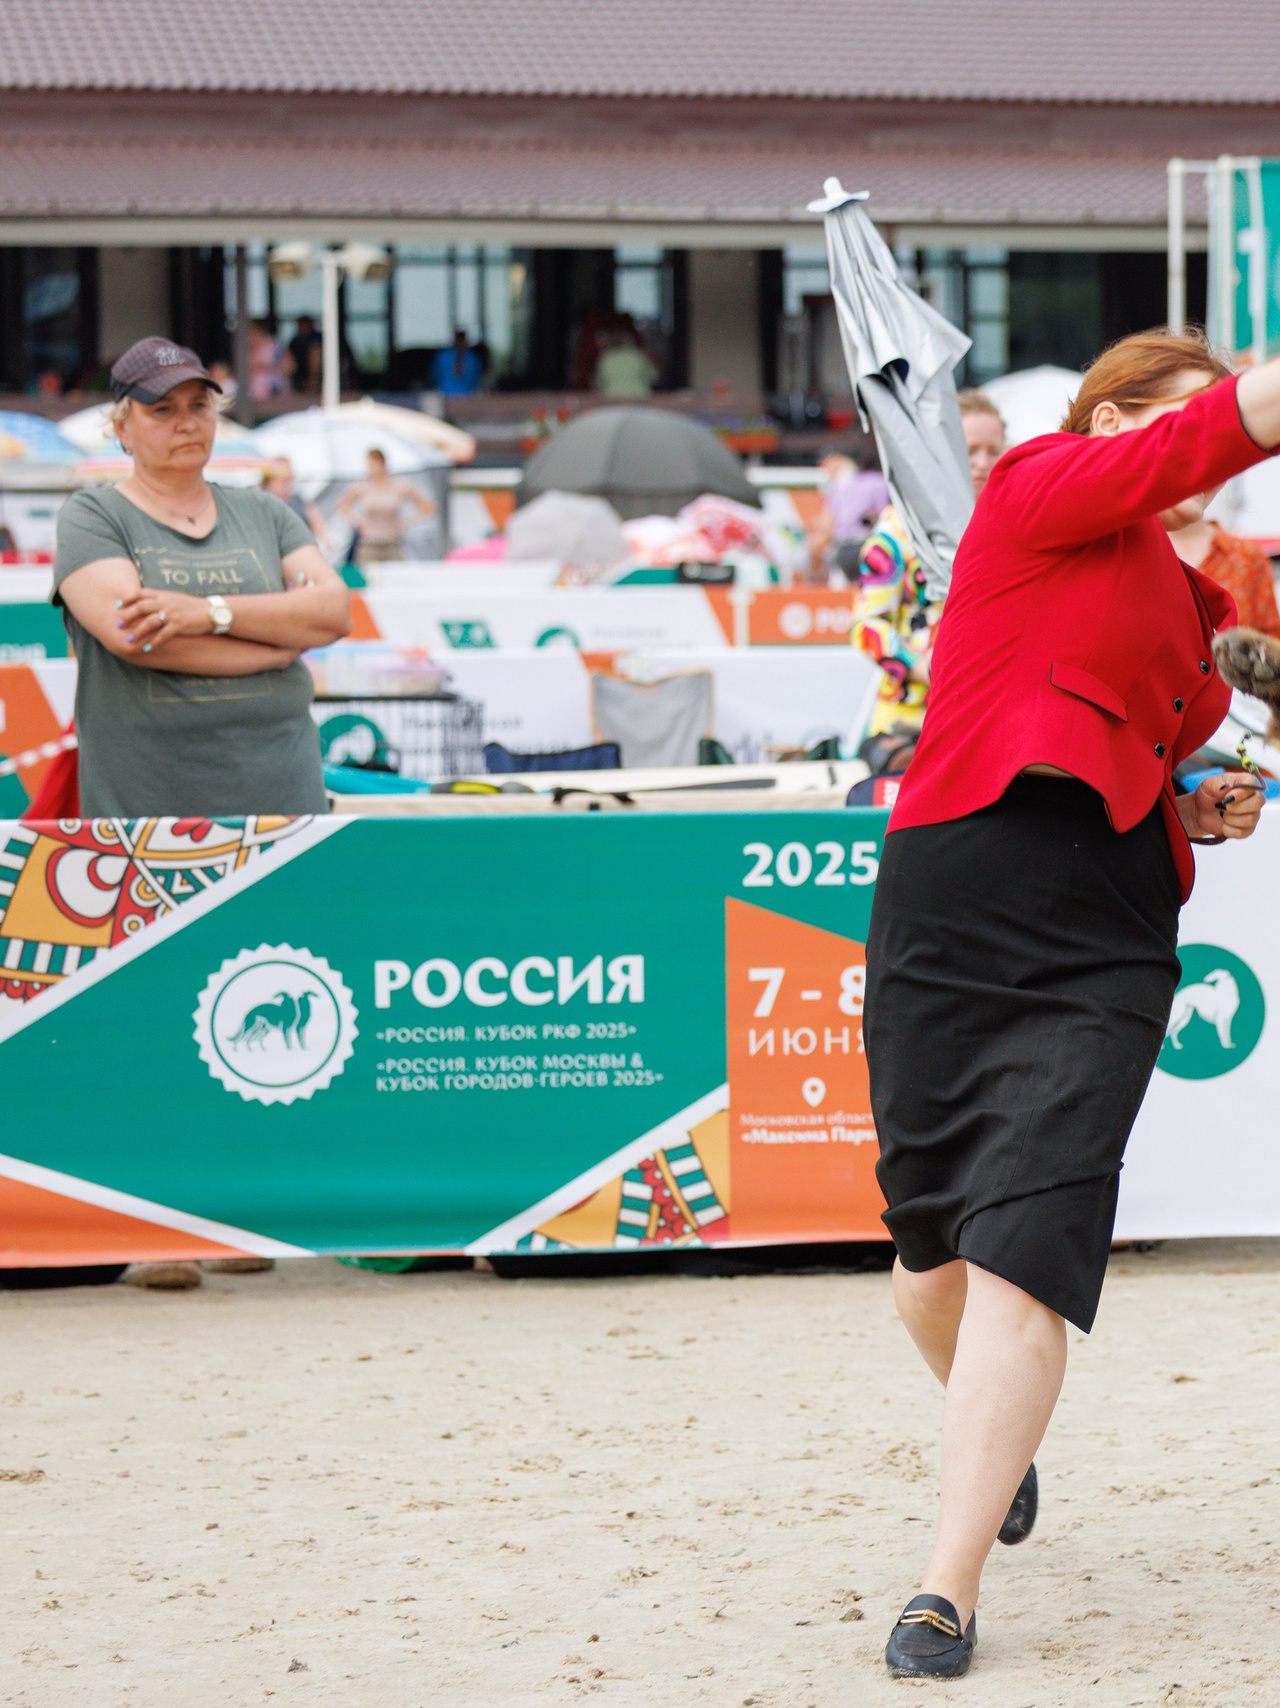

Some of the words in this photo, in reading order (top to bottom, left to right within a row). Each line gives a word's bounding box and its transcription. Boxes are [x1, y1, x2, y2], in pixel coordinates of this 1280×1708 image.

[161, 569, 190, 586] TO
[197, 569, 244, 586] FALL
[742, 841, 879, 887] 2025
[374, 954, 645, 1009] РОССИЯ
[748, 967, 785, 1017] 7
[474, 1025, 537, 1042] КУБОК
[542, 1024, 581, 1040] РКФ
[585, 1022, 637, 1039] 2025»
[474, 1056, 538, 1073] КУБОК
[543, 1053, 626, 1070] МОСКВЫ
[630, 1053, 644, 1069] &
[376, 1075, 440, 1092] КУБОК
[444, 1071, 609, 1091] ГОРОДОВ-ГЕРОЕВ
[612, 1069, 664, 1087] 2025»
[739, 1113, 825, 1127] Московская
[826, 1109, 873, 1125] област
[740, 1127, 829, 1144] «Максима
[830, 1125, 877, 1146] Парк
